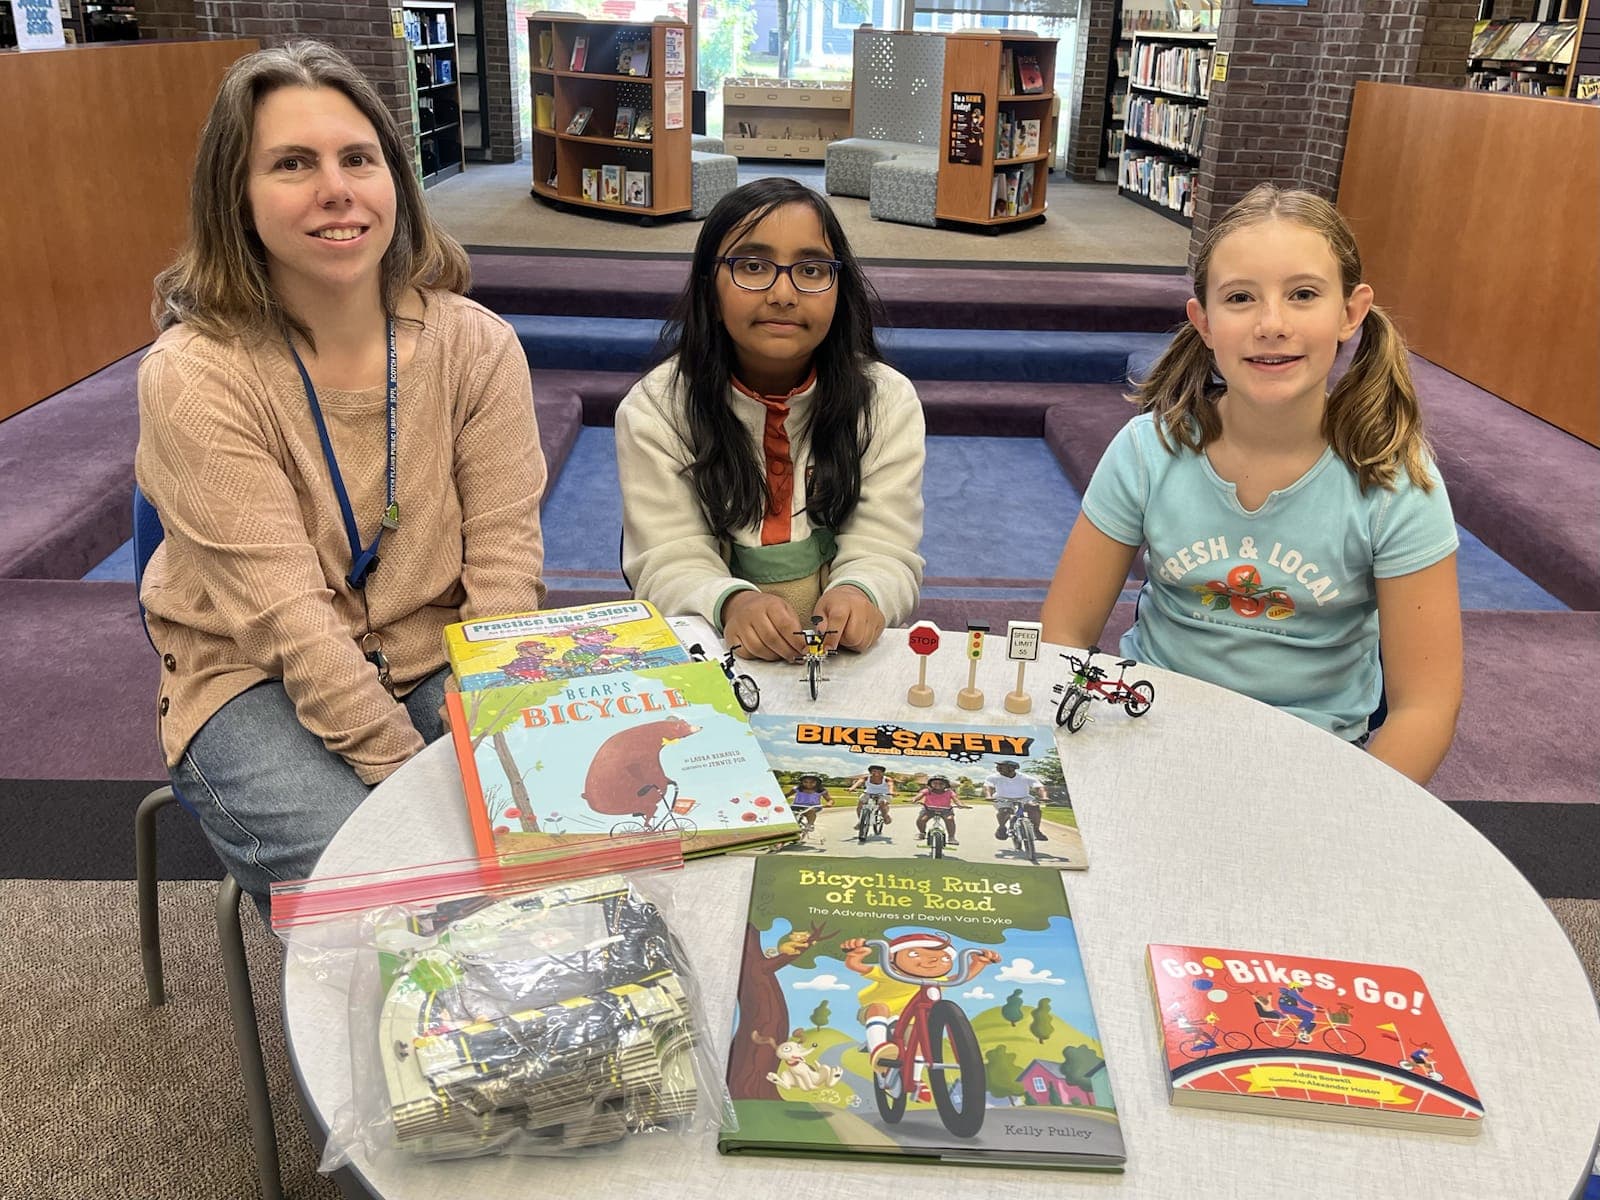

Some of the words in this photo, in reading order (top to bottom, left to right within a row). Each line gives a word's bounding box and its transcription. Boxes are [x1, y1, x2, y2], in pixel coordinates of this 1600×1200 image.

[1159, 536, 1230, 585] FRESH
[1239, 536, 1258, 560] &
[473, 619, 544, 632] Practice
[547, 614, 584, 624] Bike
[586, 605, 638, 619] Safety
[911, 636, 937, 646] STOP
[566, 681, 631, 700] BEAR'S
[519, 687, 691, 729] BICYCLE
[797, 724, 878, 746] BIKE
[892, 731, 1029, 754] SAFETY
[850, 744, 862, 753] A
[864, 746, 901, 755] Crash
[903, 748, 949, 757] Course
[799, 870, 931, 894] Bicycling
[943, 877, 1023, 896] Rules
[826, 889, 856, 904] of
[865, 891, 913, 908] the
[924, 894, 996, 912] Road
[808, 906, 829, 916] The
[832, 908, 900, 920] Adventures
[903, 912, 915, 920] of
[918, 913, 952, 922] Devin
[954, 915, 980, 924] Van
[982, 916, 1013, 926] Dyke
[1161, 957, 1215, 979] Go,
[1224, 959, 1347, 996] Bikes,
[1353, 976, 1425, 1016] Go!
[1307, 1080, 1349, 1091] Alexander
[1005, 1124, 1043, 1137] Kelly
[1047, 1126, 1093, 1139] Pulley
